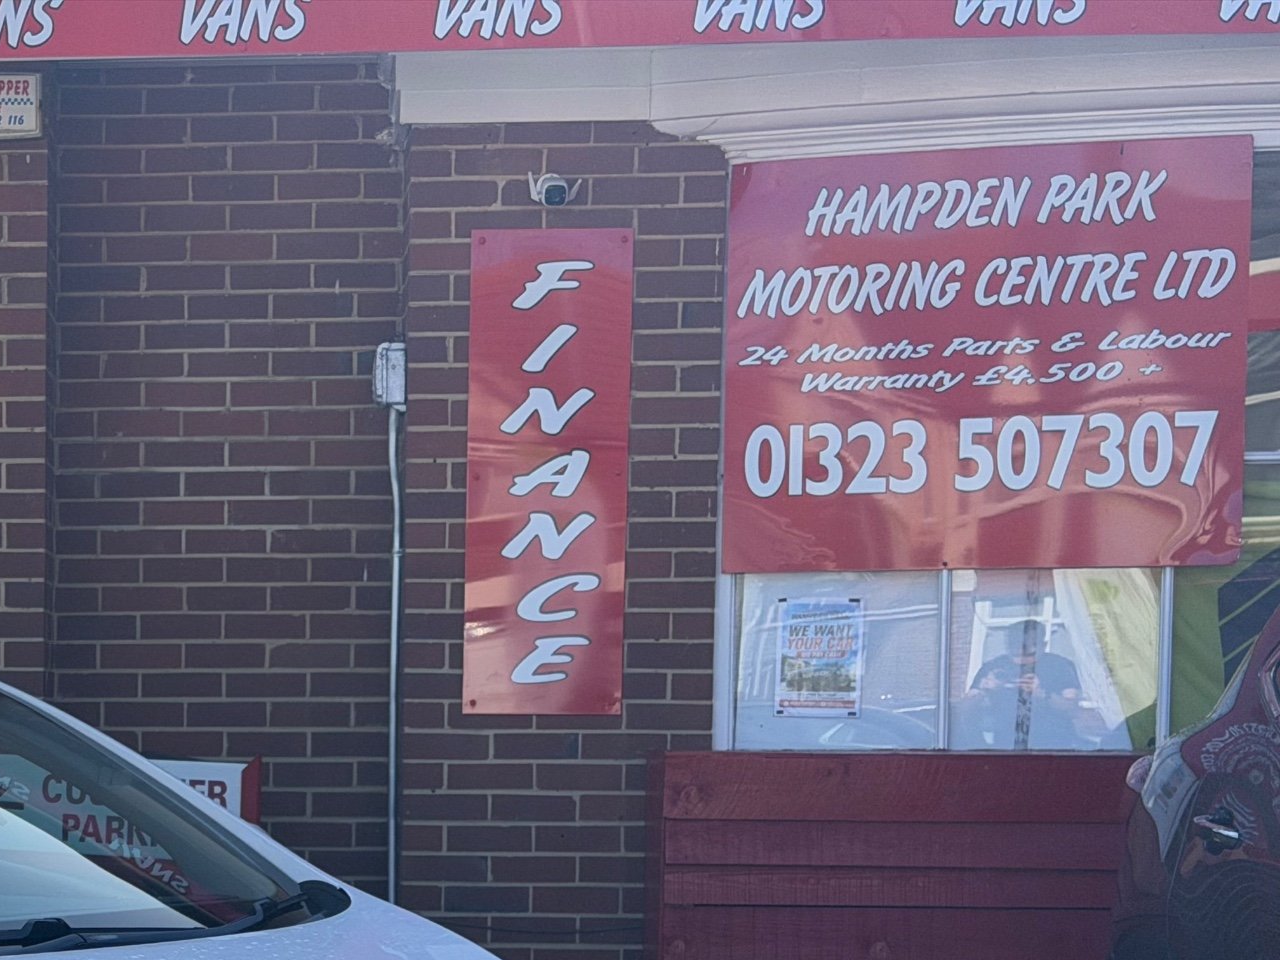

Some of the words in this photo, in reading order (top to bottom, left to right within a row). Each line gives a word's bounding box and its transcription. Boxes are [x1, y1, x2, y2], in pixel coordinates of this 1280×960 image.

[179, 0, 312, 46] VANS
[433, 0, 563, 40] VANS
[8, 115, 25, 126] 116
[804, 176, 1031, 238] HAMPDEN
[1036, 169, 1168, 226] PARK
[736, 258, 966, 319] MOTORING
[974, 251, 1147, 308] CENTRE
[1152, 248, 1238, 301] LTD
[738, 344, 788, 367] 24
[797, 339, 931, 365] Months
[941, 334, 1040, 359] Parts
[1050, 331, 1086, 354] &
[1098, 328, 1232, 352] Labour
[800, 368, 965, 394] Warranty
[1139, 363, 1163, 375] +
[498, 260, 601, 685] FINANCE
[743, 419, 928, 499] 01323
[953, 409, 1220, 493] 507307
[789, 624, 810, 636] WE
[815, 624, 853, 636] WANT
